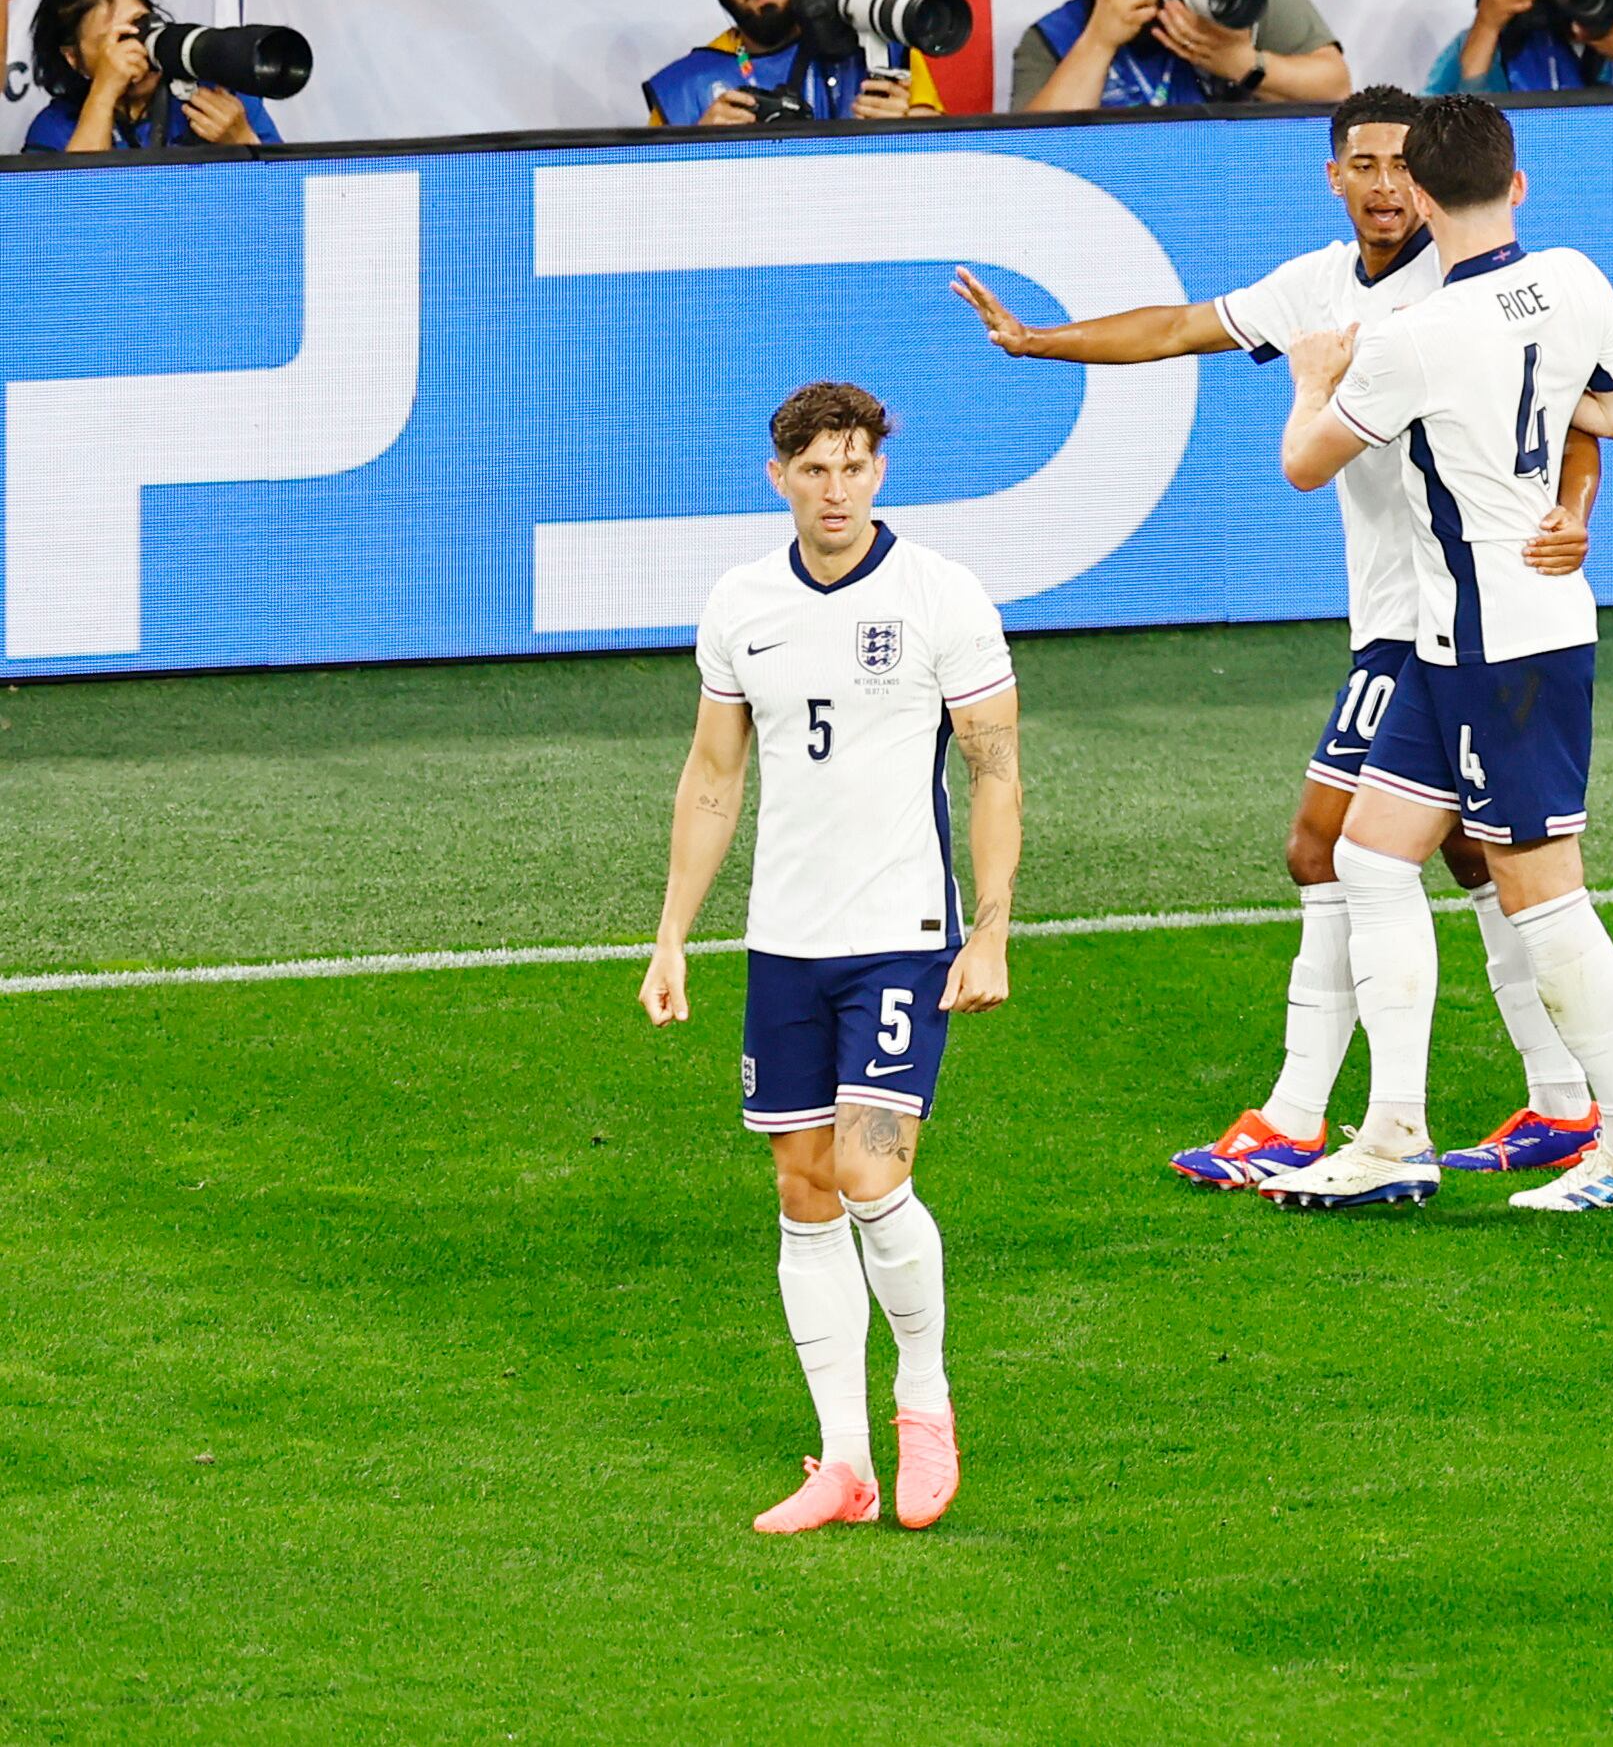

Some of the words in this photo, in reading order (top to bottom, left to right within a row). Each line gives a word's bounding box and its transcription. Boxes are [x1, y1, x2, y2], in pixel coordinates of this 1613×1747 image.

[1496, 282, 1550, 322] RICE
[1513, 342, 1550, 486] 4
[807, 698, 833, 764] 5
[1336, 669, 1396, 741] 10
[1458, 724, 1488, 790] 4
[876, 988, 915, 1057] 5
